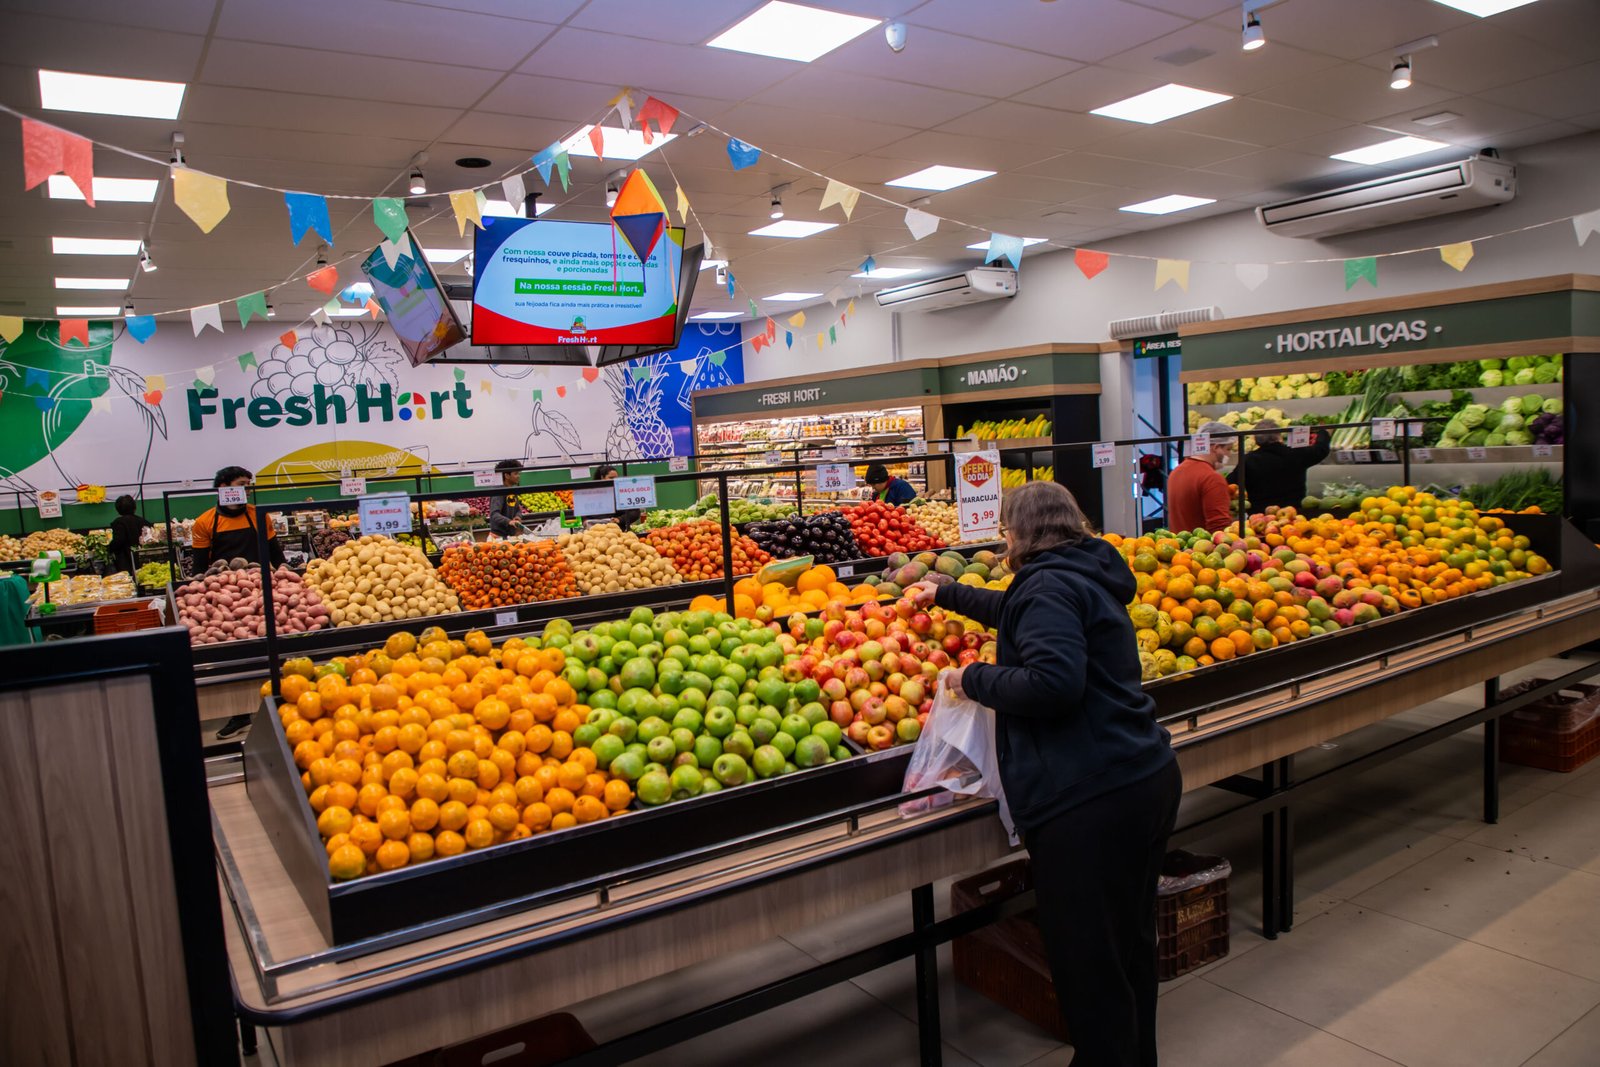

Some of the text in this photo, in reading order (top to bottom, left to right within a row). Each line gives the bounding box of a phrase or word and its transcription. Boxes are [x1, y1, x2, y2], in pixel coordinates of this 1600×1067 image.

[503, 255, 551, 265] fresquinhos,
[572, 251, 598, 259] picada,
[563, 266, 608, 274] porcionadas
[520, 282, 532, 290] Na
[563, 283, 592, 291] sessão
[619, 285, 640, 293] Hort,
[558, 335, 579, 343] Fresh
[1276, 320, 1428, 353] HORTALIÇAS
[968, 364, 1019, 386] MAMÃO
[762, 388, 821, 406] FRESH HORT
[186, 383, 348, 431] Fresh
[962, 462, 994, 474] OFERTA
[825, 480, 841, 488] 3,99
[627, 496, 646, 506] 3,99
[962, 494, 998, 503] MARACUJA
[971, 510, 995, 525] 3,99
[375, 520, 399, 531] 3,99
